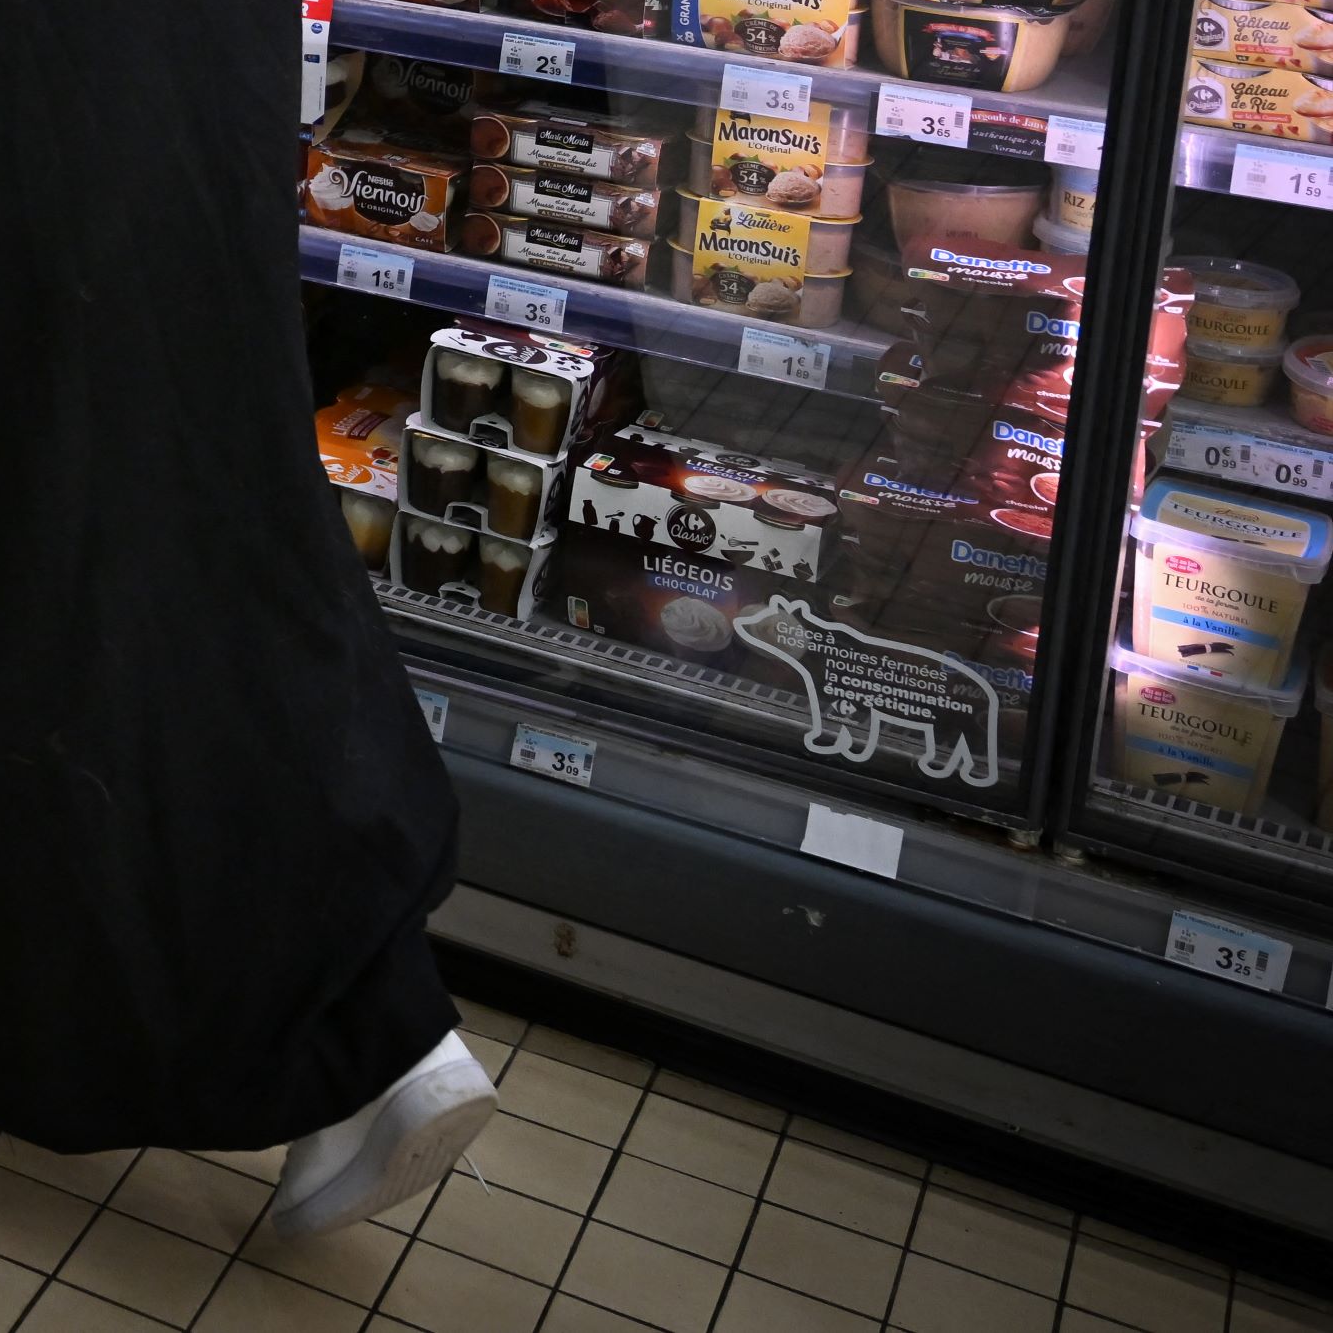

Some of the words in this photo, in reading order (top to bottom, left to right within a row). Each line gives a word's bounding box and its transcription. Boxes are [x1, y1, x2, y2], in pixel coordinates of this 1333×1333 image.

[539, 129, 562, 144] Marie
[564, 134, 589, 148] Morin
[718, 121, 822, 155] MaronSui's
[330, 168, 428, 213] Viennois
[367, 175, 394, 188] Nestlé
[699, 233, 801, 268] MaronSui's
[930, 248, 1052, 275] Danette
[946, 265, 1030, 282] mousse
[962, 276, 1014, 288] chocolat
[670, 523, 711, 545] Classic
[1172, 503, 1302, 539] TEURGOULE
[643, 554, 734, 592] LIÉGEOIS
[654, 576, 718, 601] CHOCOLAT
[1163, 572, 1279, 614] TEURGOULE
[776, 620, 824, 645] Grâce
[826, 631, 835, 644] à
[1204, 620, 1241, 638] Vanille
[1212, 610, 1249, 626] NATUREL
[776, 635, 806, 651] nos
[808, 640, 879, 665] armoires
[880, 652, 948, 682] fermées
[825, 669, 840, 683] la
[842, 675, 974, 715] consommation
[826, 659, 862, 676] nous
[864, 667, 947, 694] réduisons
[823, 682, 937, 720] énergétique.
[1138, 702, 1253, 747] TEURGOULE
